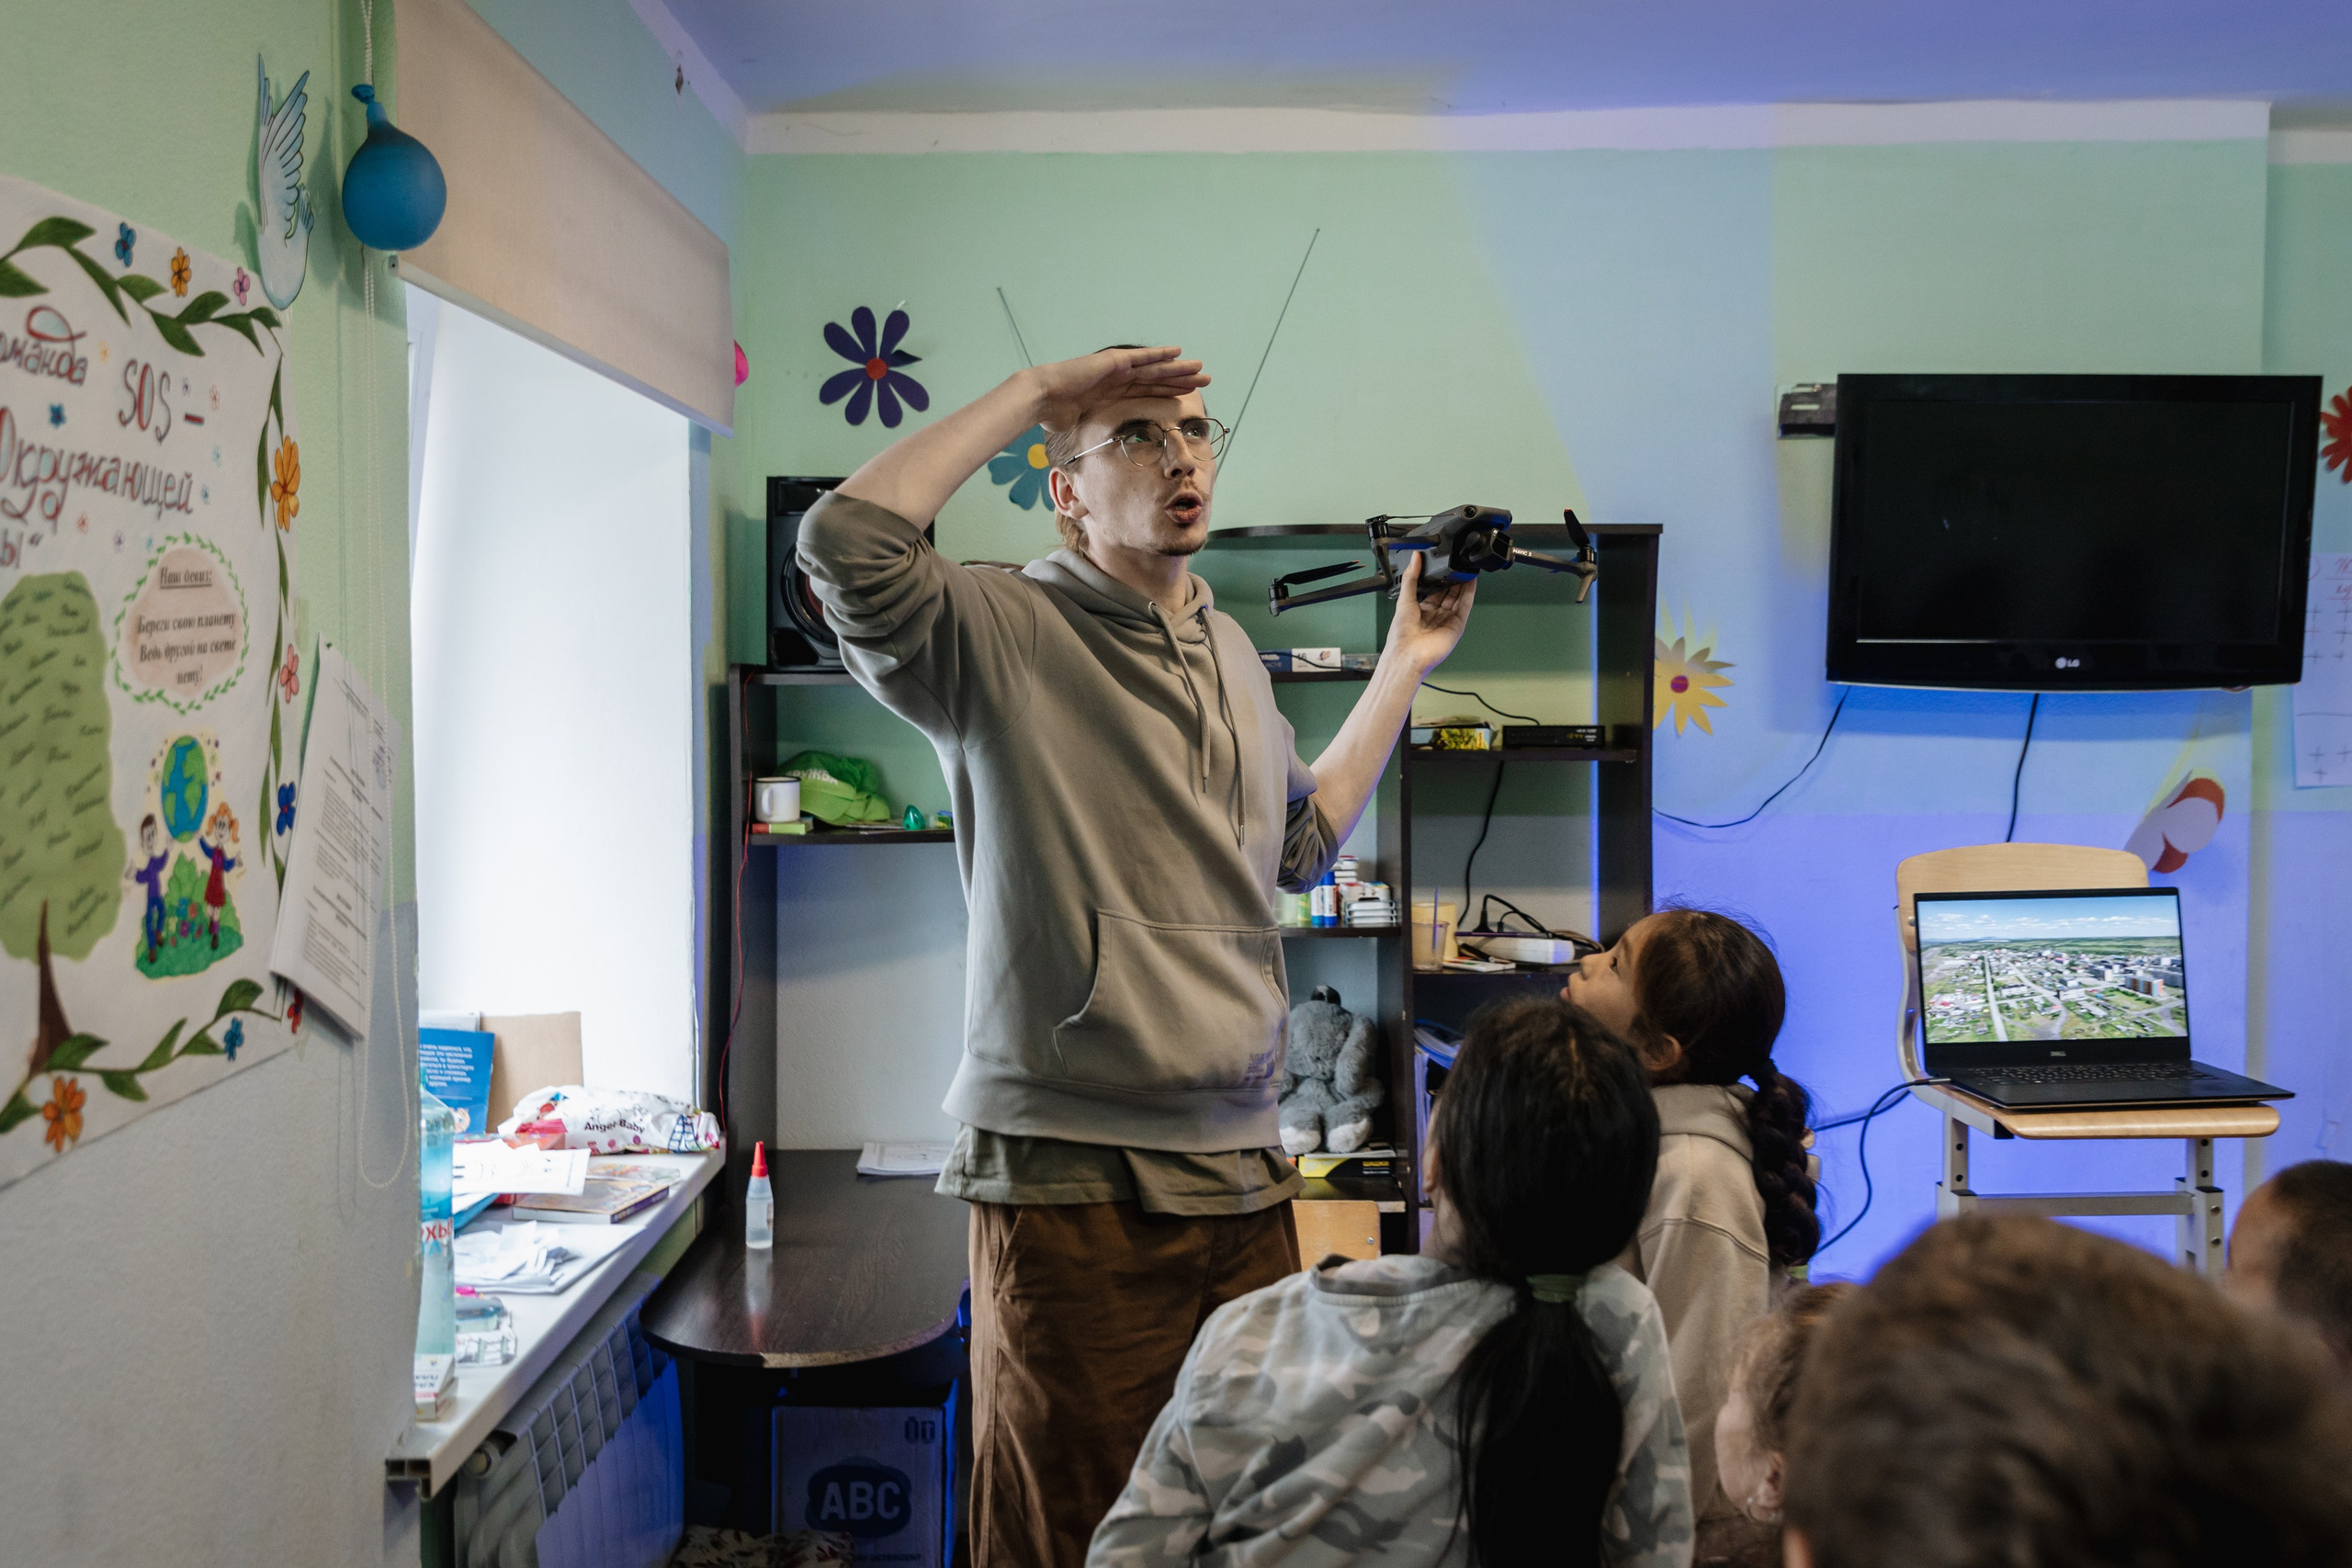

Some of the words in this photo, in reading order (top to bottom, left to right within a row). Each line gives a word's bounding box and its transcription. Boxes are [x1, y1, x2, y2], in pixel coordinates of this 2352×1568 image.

[118, 358, 173, 446] SOS
[160, 567, 182, 584] Наш
[184, 570, 212, 582] девиз:
[138, 615, 170, 637] Береги
[173, 617, 196, 631] свою
[198, 613, 236, 630] планету
[140, 644, 163, 662] Ведь
[164, 640, 195, 663] другой
[197, 644, 208, 654] на
[2067, 659, 2080, 668] LG
[619, 1119, 644, 1134] Baby
[820, 1480, 901, 1521] ABC
